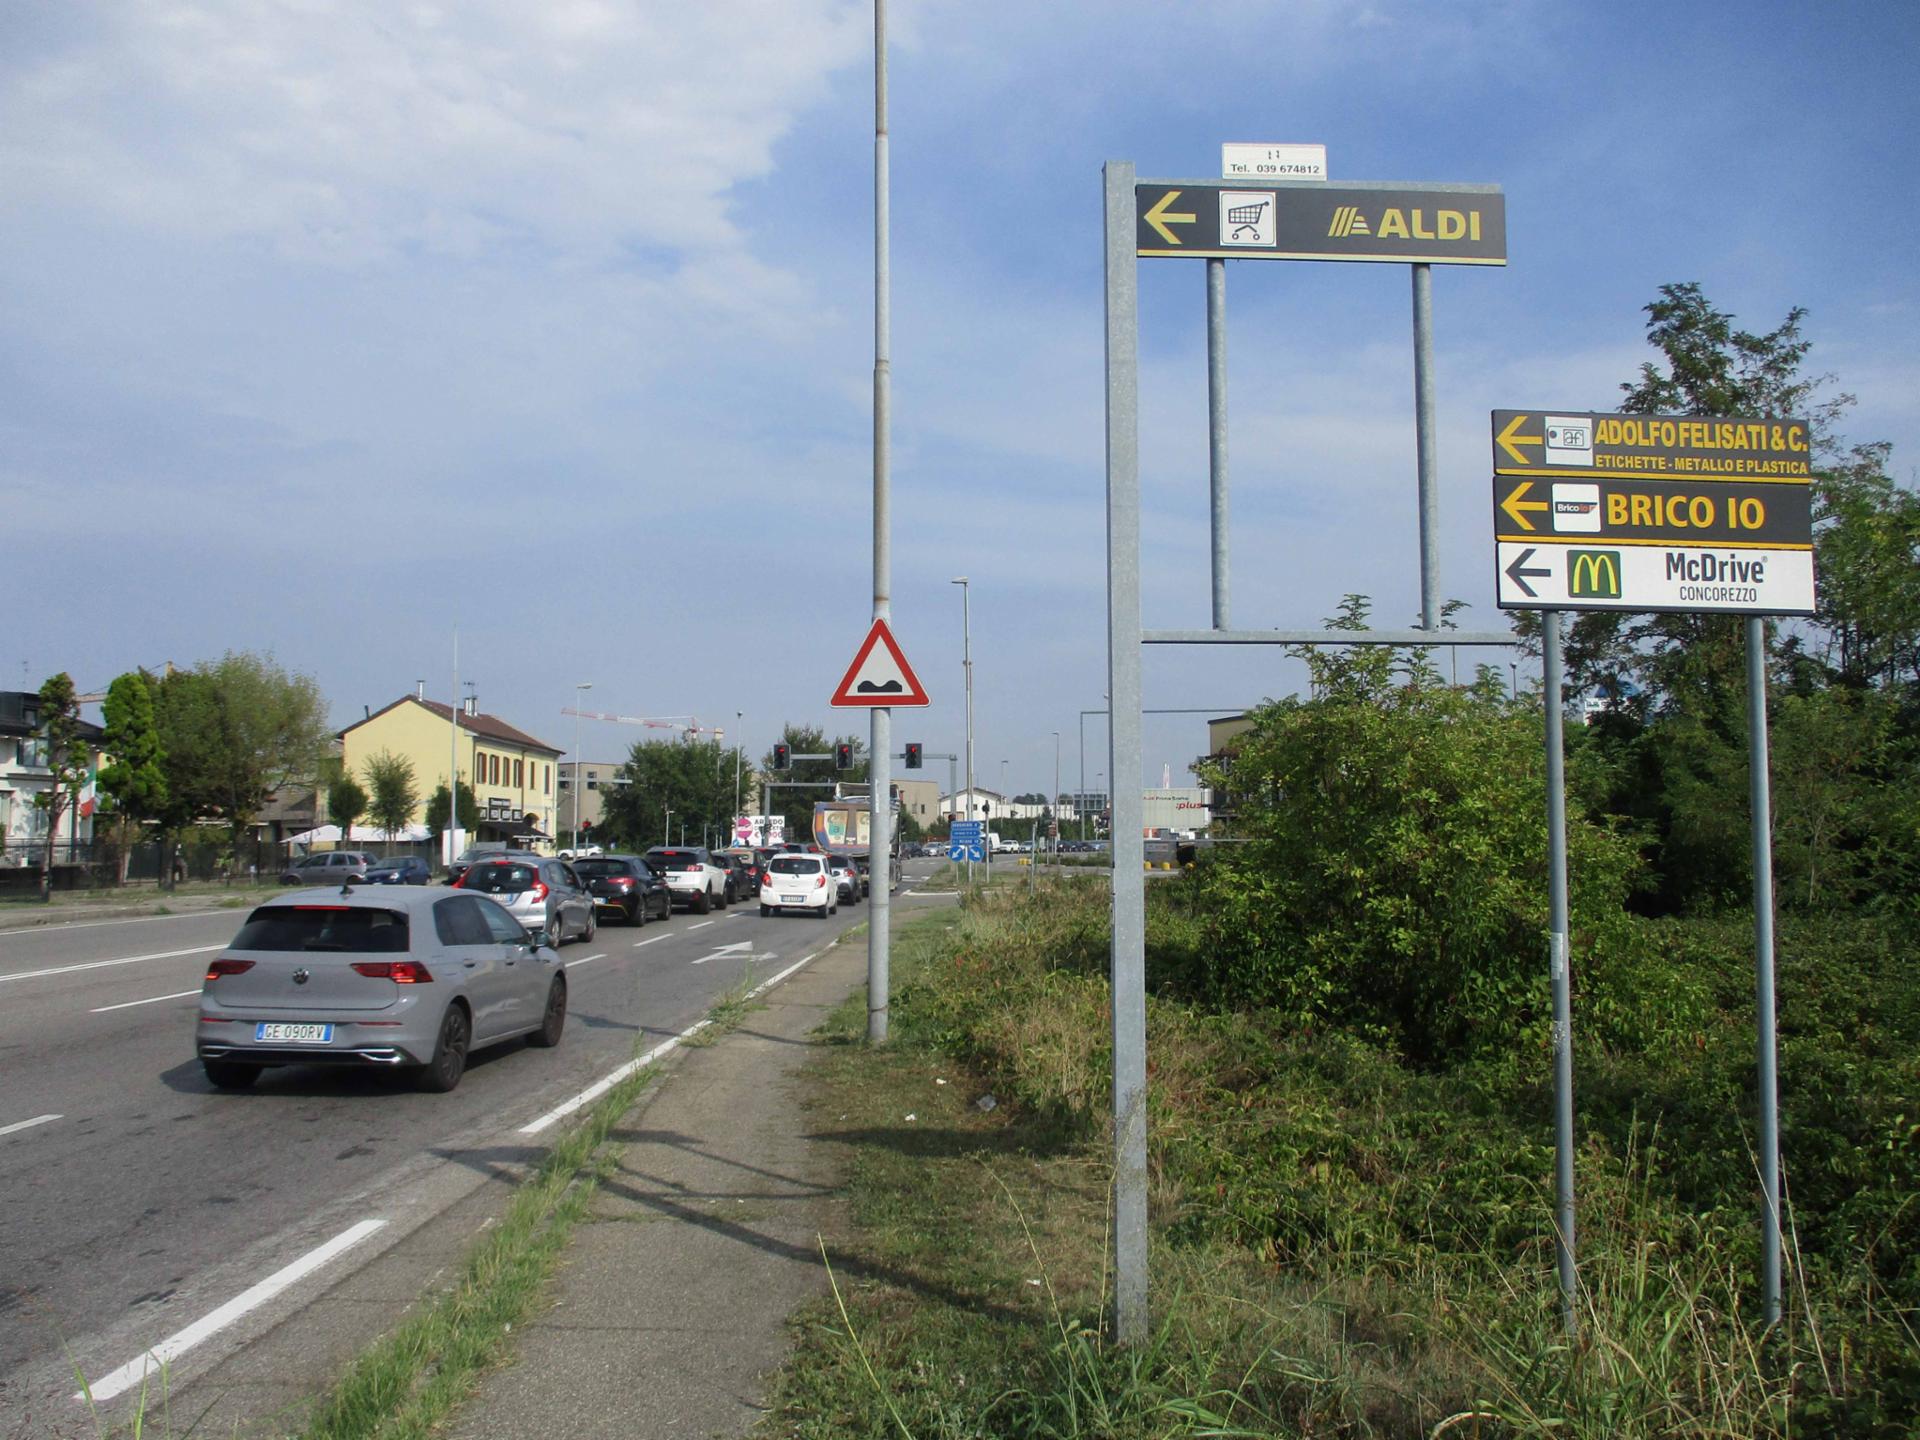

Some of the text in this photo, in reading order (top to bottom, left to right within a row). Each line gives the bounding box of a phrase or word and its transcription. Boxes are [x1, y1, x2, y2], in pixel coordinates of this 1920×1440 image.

[1231, 164, 1320, 174] Tel. 039 674812
[1377, 208, 1480, 241] ALDI
[1594, 419, 1808, 452] ADOLFO FELISATI & C.
[1595, 454, 1666, 470] ETICHETTE
[1674, 457, 1734, 472] METALLO
[1736, 459, 1744, 472] E
[1746, 460, 1808, 475] PLASTICA
[1607, 494, 1765, 530] BRICO IO
[1680, 586, 1757, 602] CONCOREZZO
